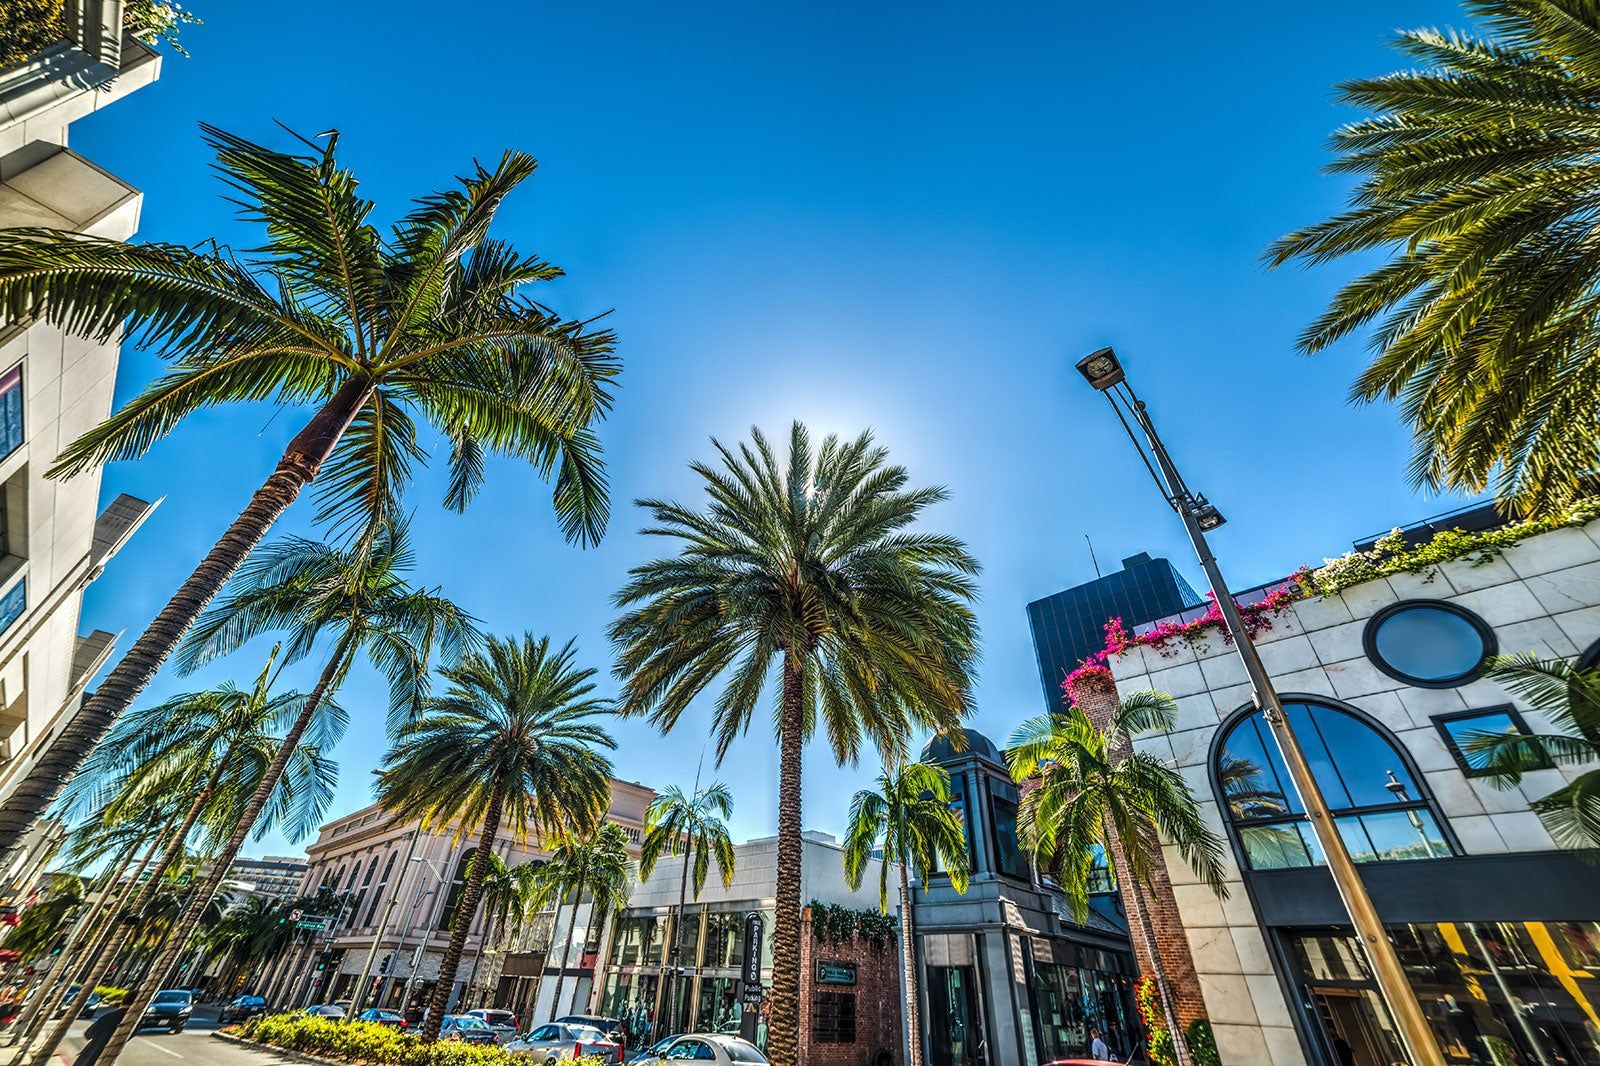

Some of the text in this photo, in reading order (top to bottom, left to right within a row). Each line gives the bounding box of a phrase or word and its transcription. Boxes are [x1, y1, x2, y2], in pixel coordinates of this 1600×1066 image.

[751, 926, 759, 971] PARKING
[744, 984, 762, 992] Public
[744, 994, 762, 1003] Parking
